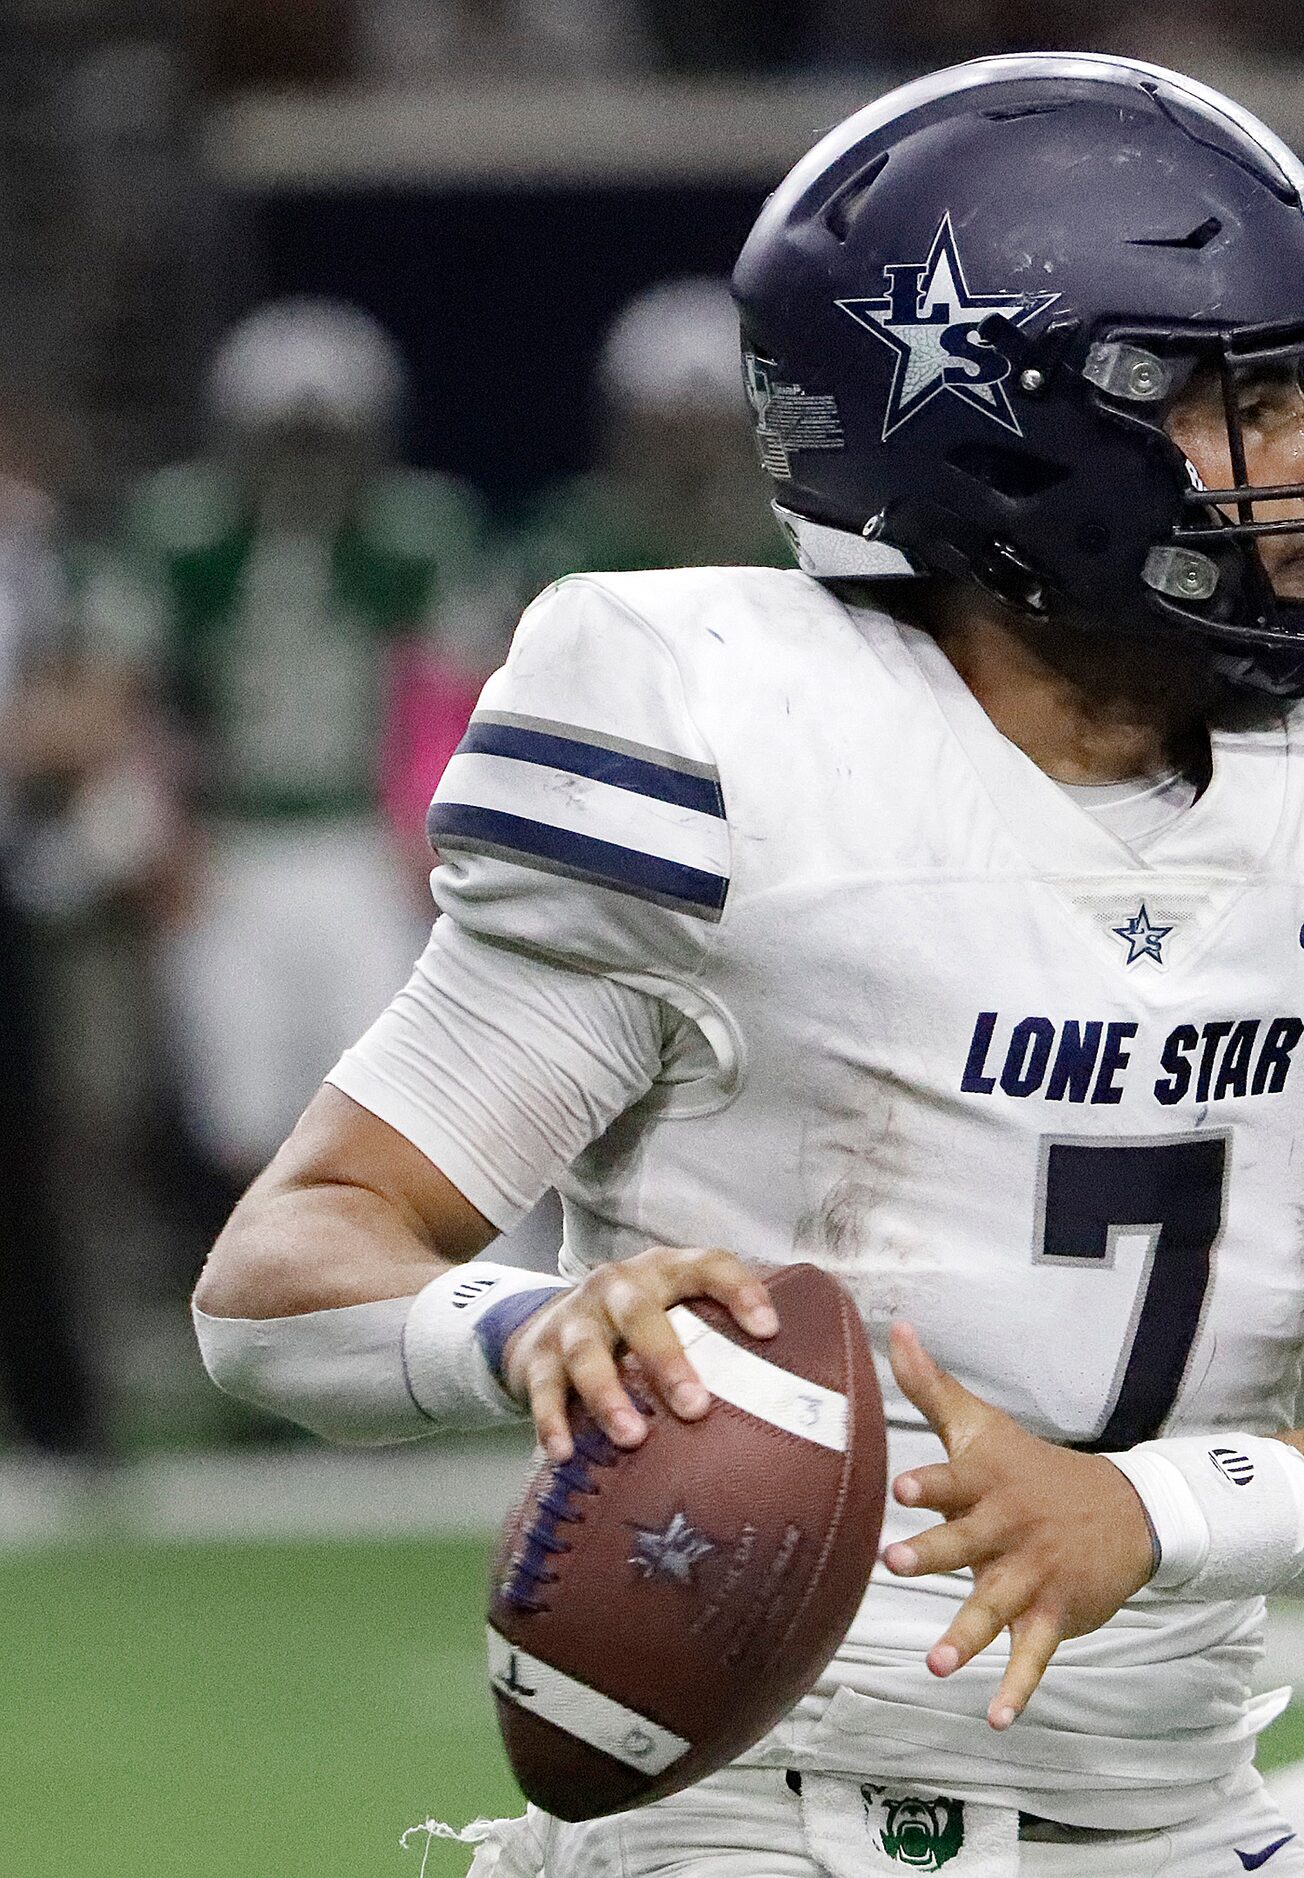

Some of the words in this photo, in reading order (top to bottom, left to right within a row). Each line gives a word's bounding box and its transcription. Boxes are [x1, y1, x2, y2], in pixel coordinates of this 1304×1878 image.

[960, 1011, 1138, 1105] LONE
[1153, 1016, 1304, 1105] STAR
[1031, 1125, 1234, 1452] 7
